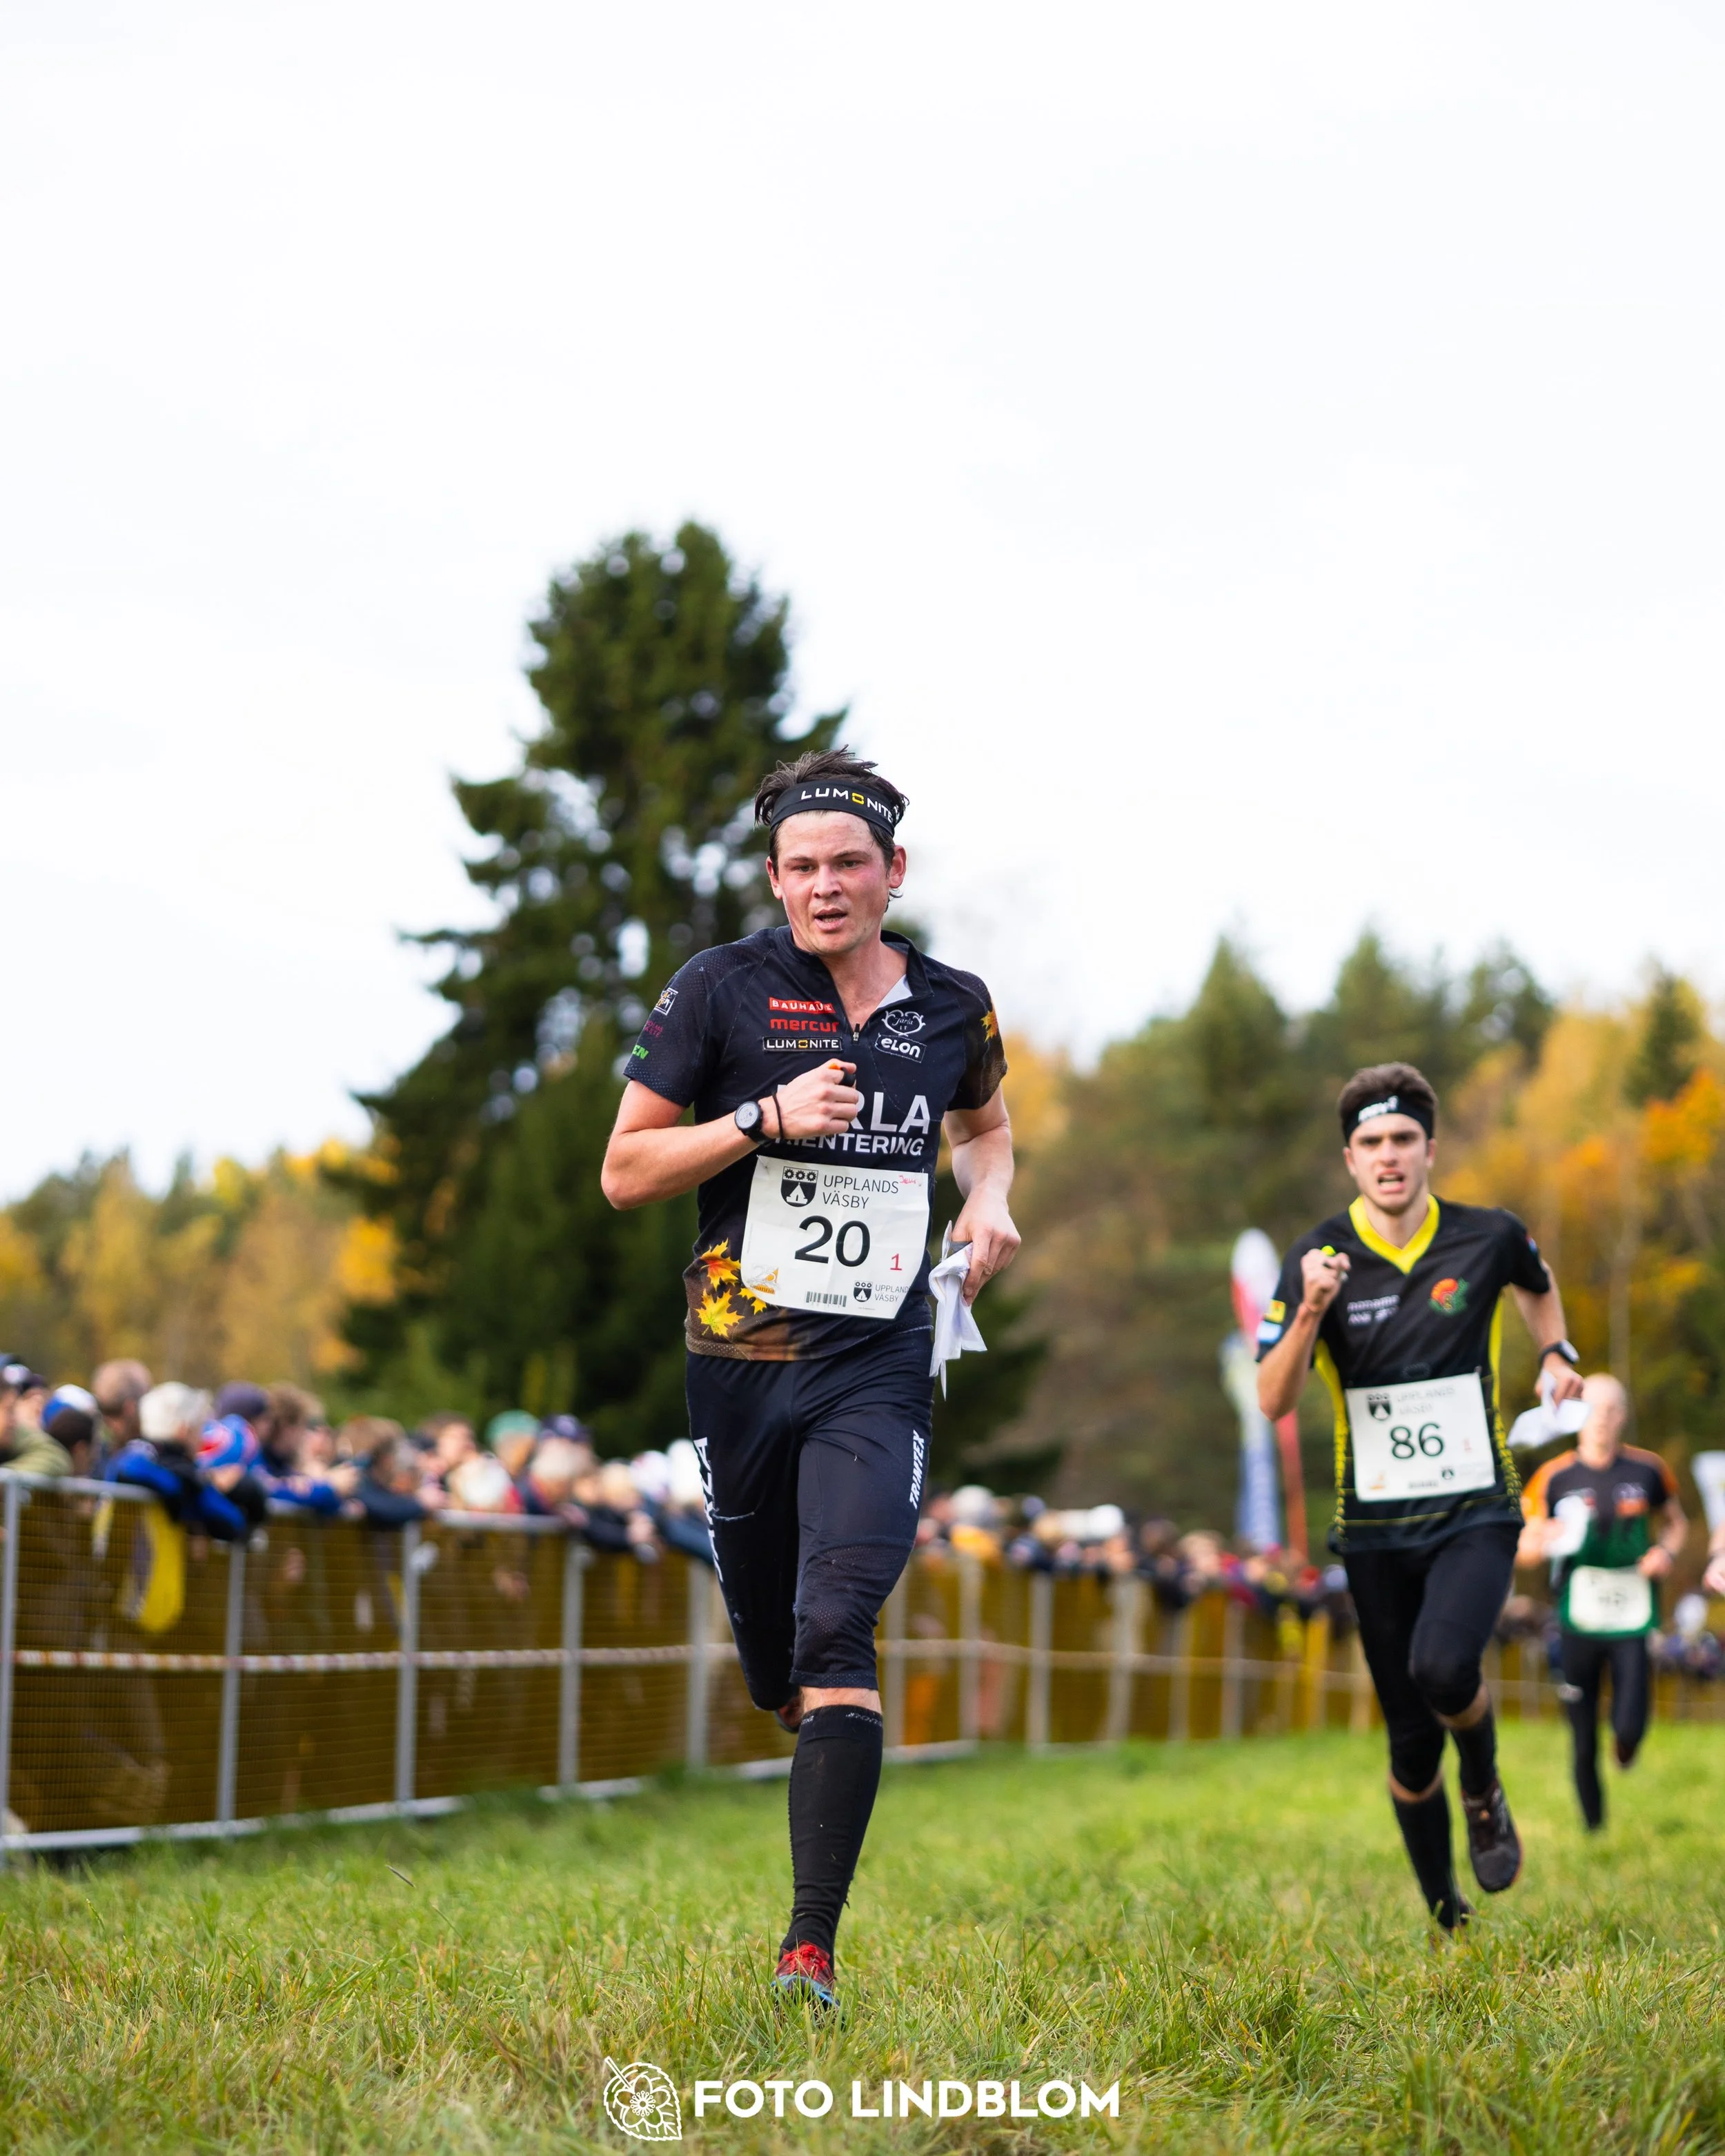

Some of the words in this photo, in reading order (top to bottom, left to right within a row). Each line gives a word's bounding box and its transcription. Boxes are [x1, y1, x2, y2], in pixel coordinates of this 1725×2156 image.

[800, 788, 893, 823] LUMONITE
[770, 1018, 840, 1033] mercur
[767, 1039, 840, 1049] LUMONITE
[823, 1174, 899, 1194] UPPLANDS
[822, 1190, 869, 1209] VÄSBY
[794, 1215, 871, 1267] 20
[890, 1254, 903, 1271] 1
[874, 1292, 899, 1302] VÄSBY
[875, 1284, 910, 1294] UPPLAND
[1390, 1423, 1444, 1459] 86
[909, 1429, 925, 1510] TRIMTEX
